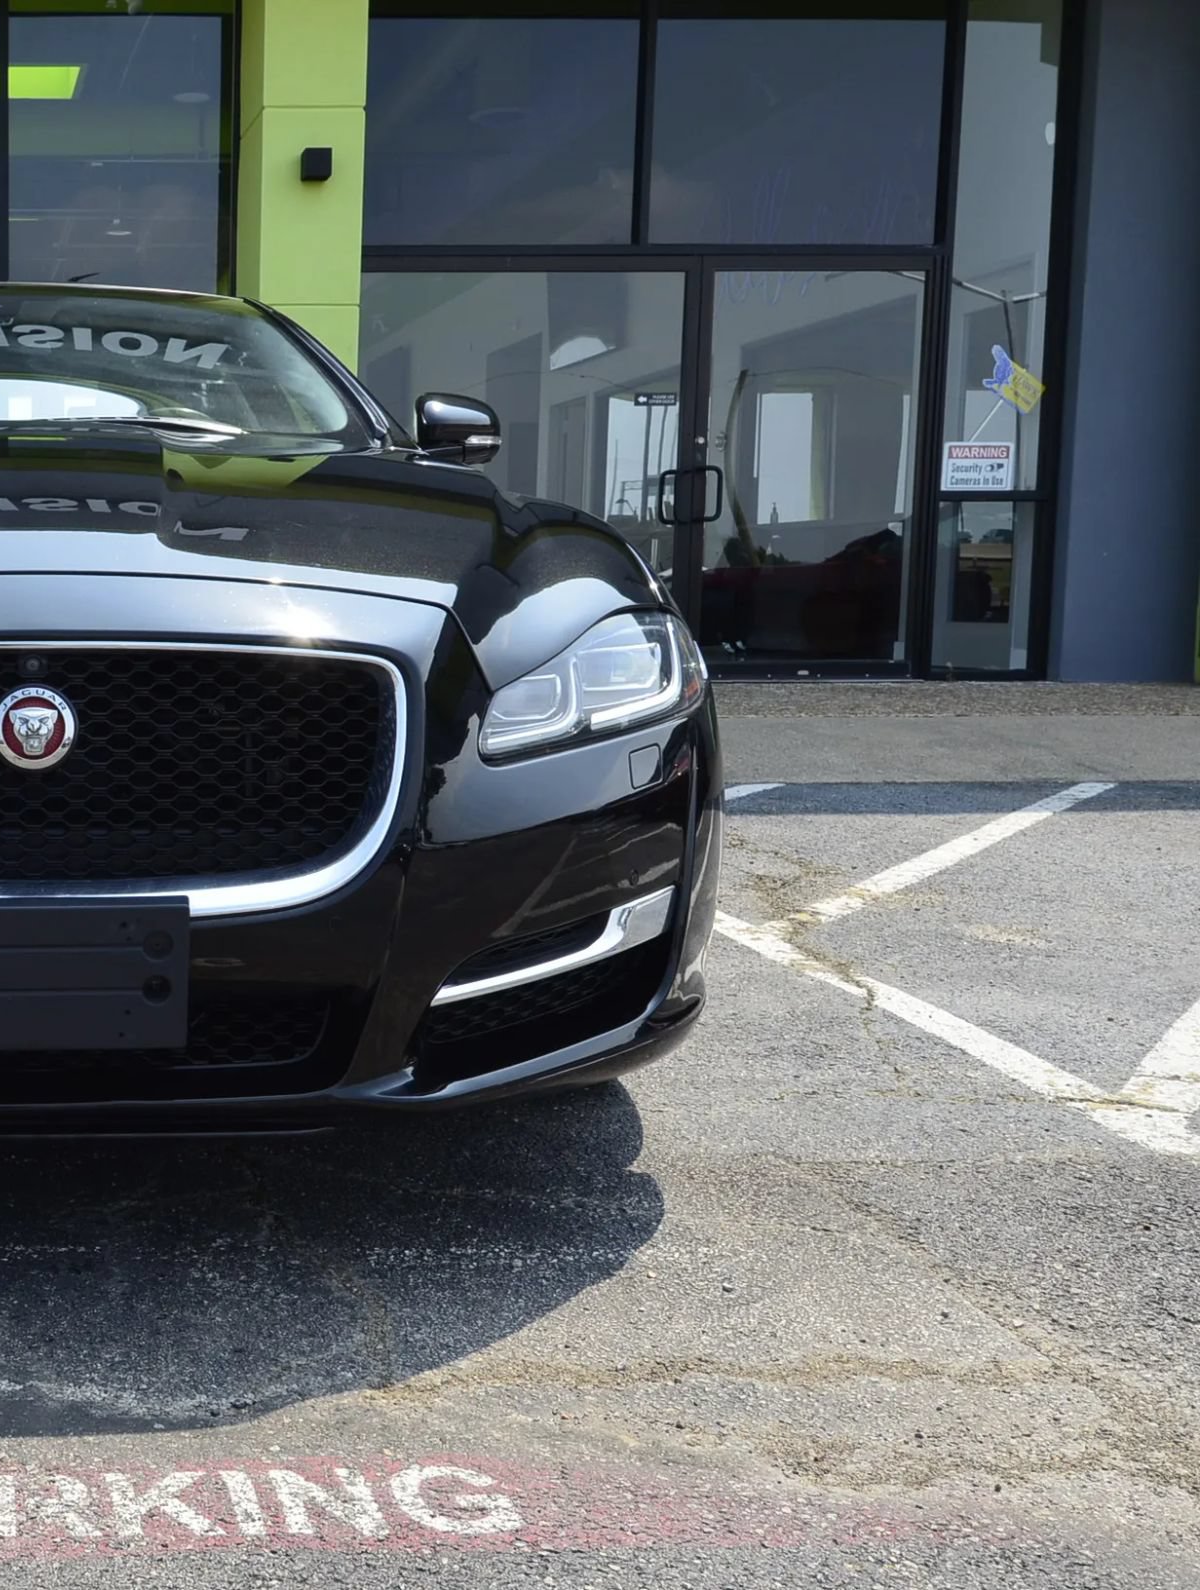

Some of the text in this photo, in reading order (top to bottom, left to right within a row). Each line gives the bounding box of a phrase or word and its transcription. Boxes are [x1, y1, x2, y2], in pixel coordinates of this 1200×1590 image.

[951, 447, 1007, 458] WARNING
[951, 463, 982, 475] Security
[950, 475, 981, 486] Cameras
[991, 475, 1004, 486] Use
[1, 689, 68, 713] JAGUAR
